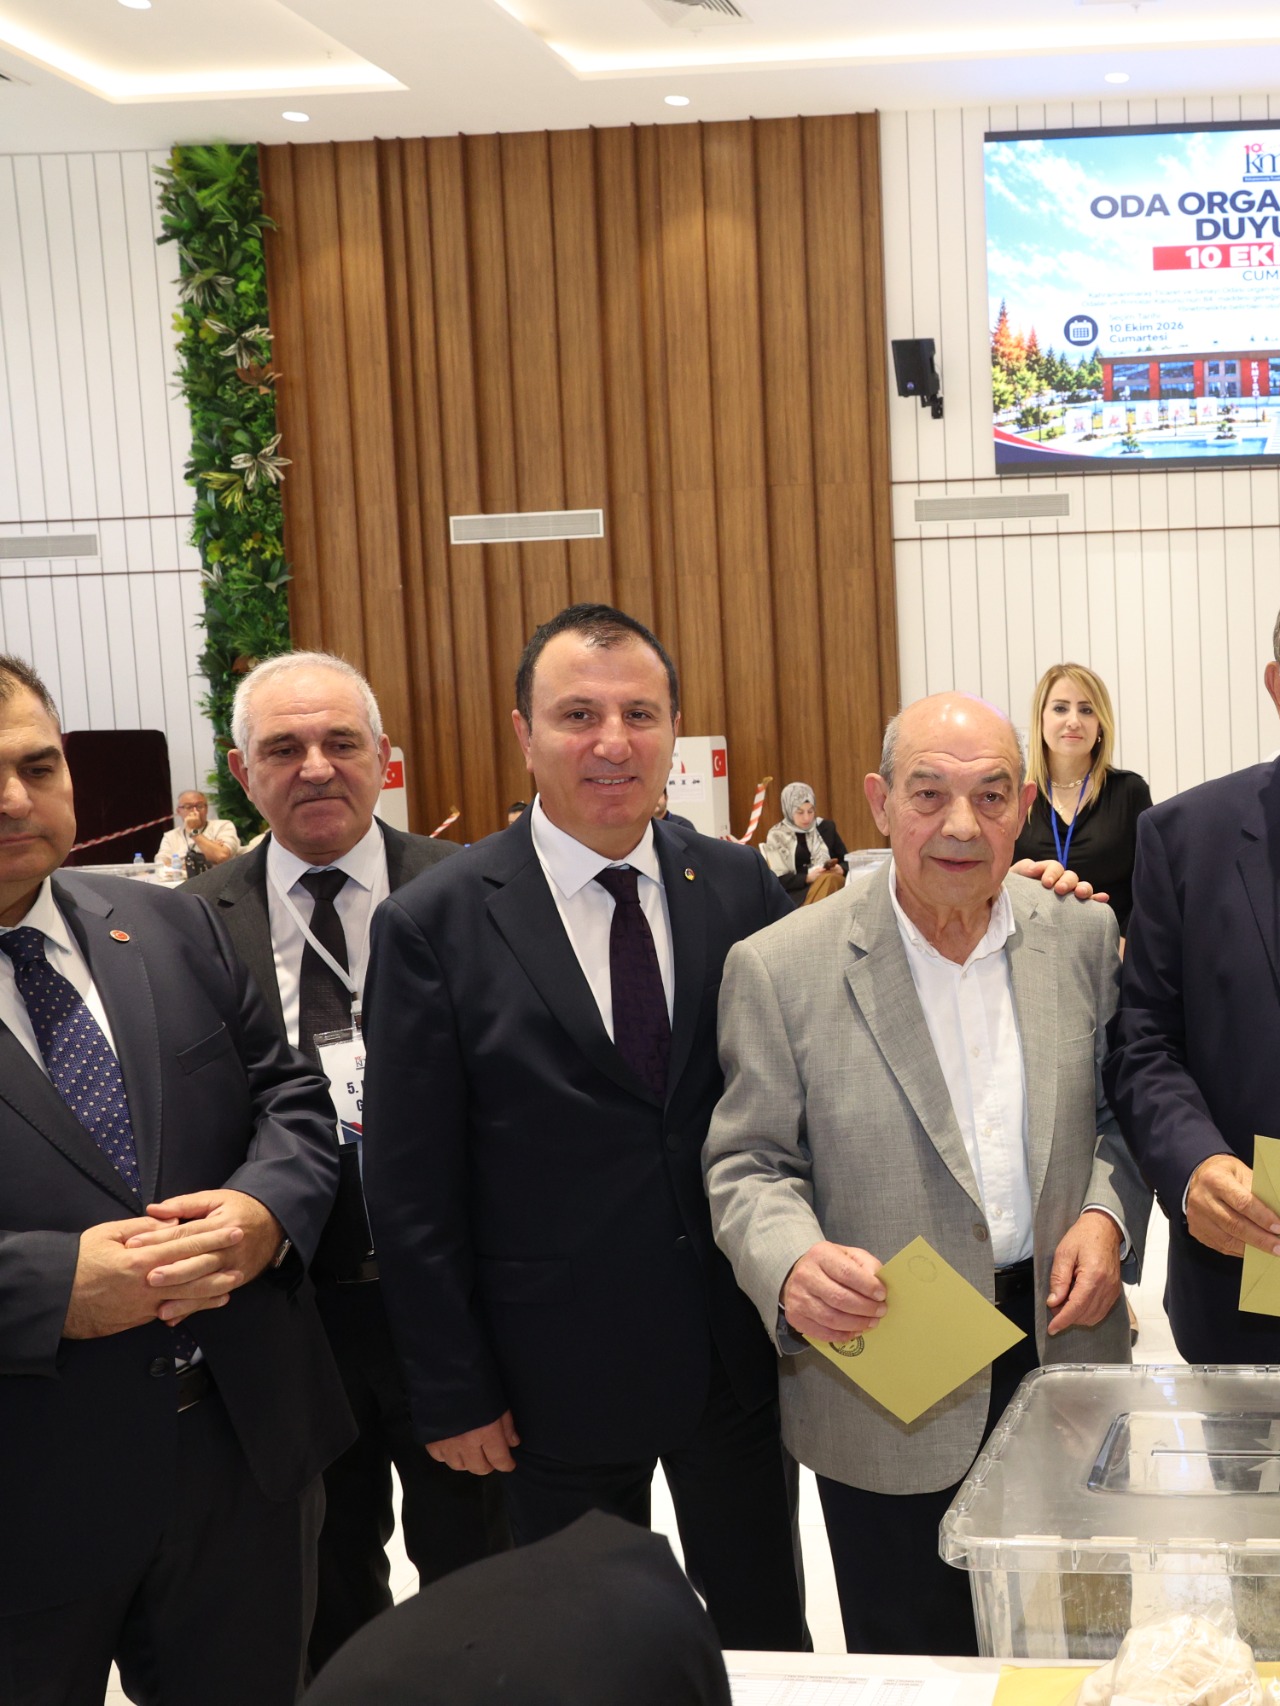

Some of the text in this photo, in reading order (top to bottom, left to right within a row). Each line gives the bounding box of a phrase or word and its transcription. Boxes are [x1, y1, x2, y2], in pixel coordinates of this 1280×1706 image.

[1090, 193, 1171, 219] ODA
[1185, 246, 1223, 269] 10
[1109, 321, 1185, 333] 10 Ekim 2026
[1109, 332, 1168, 343] Cumartesi
